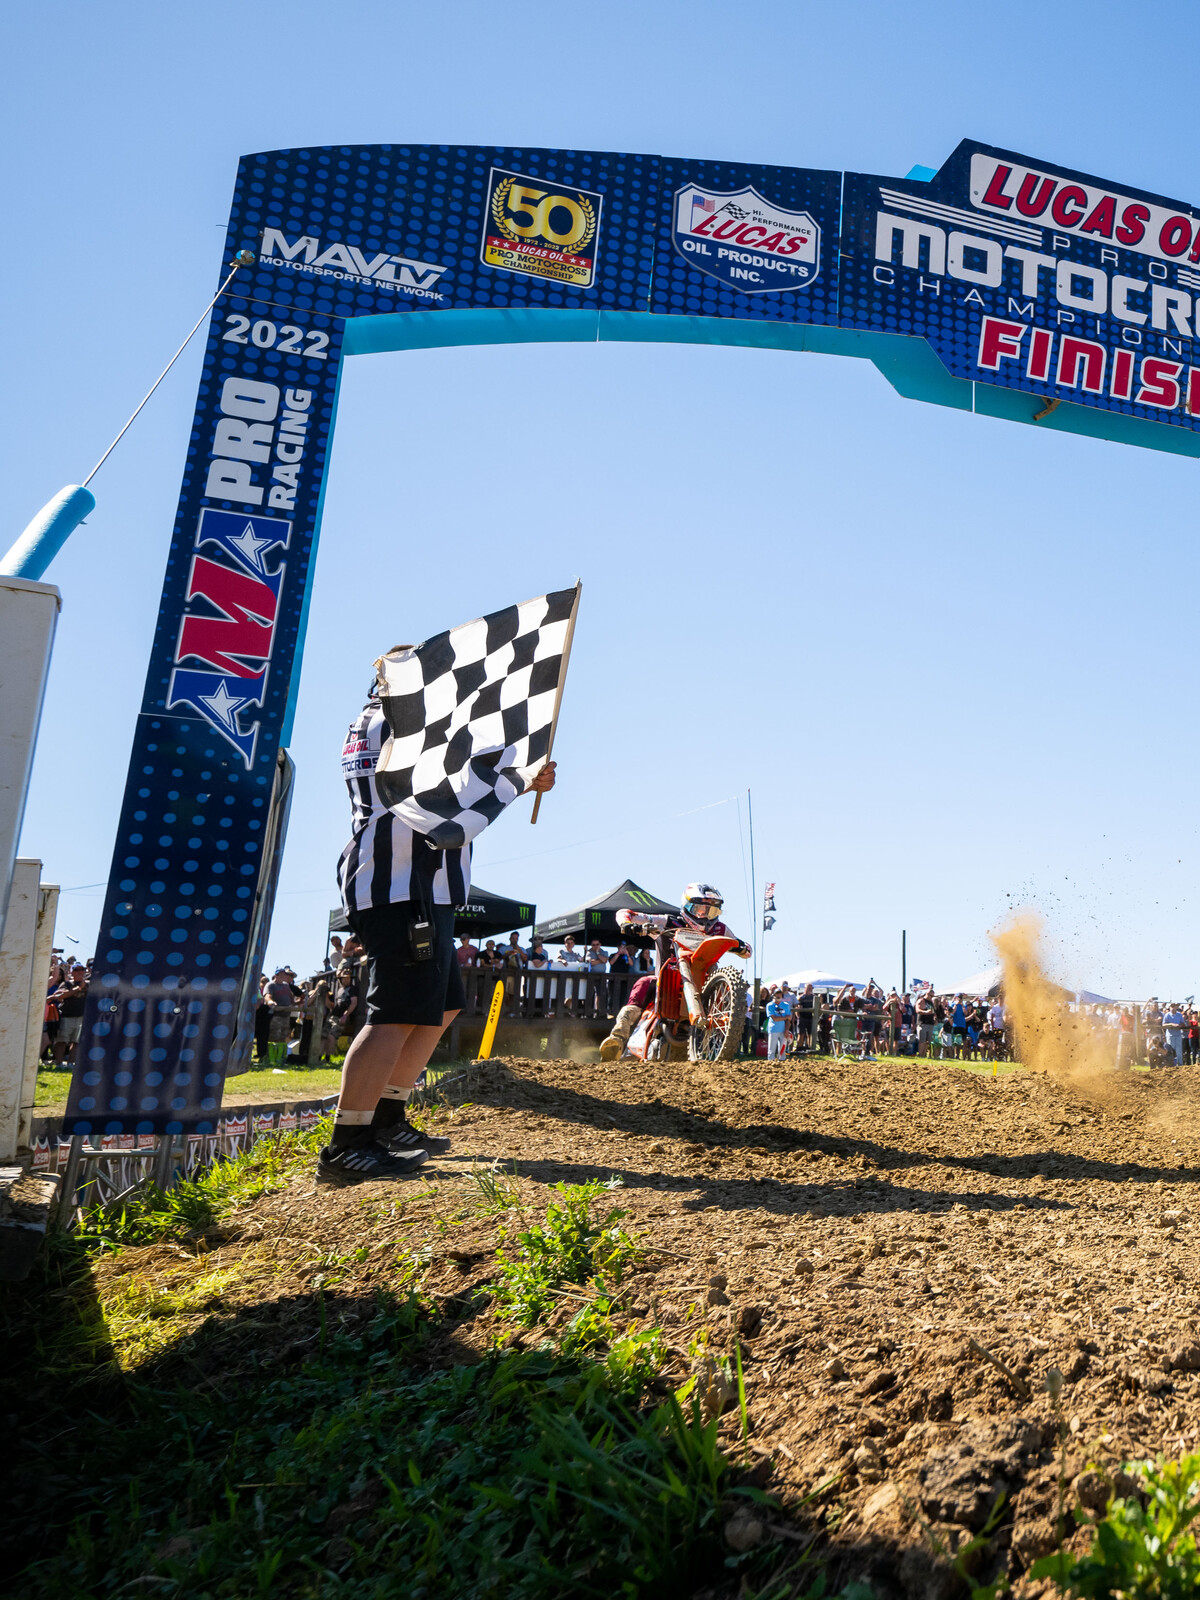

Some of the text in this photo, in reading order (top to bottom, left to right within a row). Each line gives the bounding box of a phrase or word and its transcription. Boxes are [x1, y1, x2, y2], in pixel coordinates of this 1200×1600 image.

[503, 184, 588, 246] 50
[752, 216, 812, 236] PERFORMANCE
[982, 164, 1151, 246] LUCAS
[515, 244, 565, 262] LUCAS OIL
[690, 214, 809, 255] LUCAS
[1052, 234, 1168, 280] PRO
[259, 255, 445, 302] MOTORSPORTS NETWORK
[489, 247, 588, 276] PRO MOTOCROSS
[502, 259, 574, 280] CHAMPIONSHIP
[682, 240, 809, 278] OIL PRODUCTS
[221, 314, 330, 360] 2022
[203, 376, 281, 506] PRO
[267, 388, 313, 511] RACING
[164, 507, 293, 771] AMA
